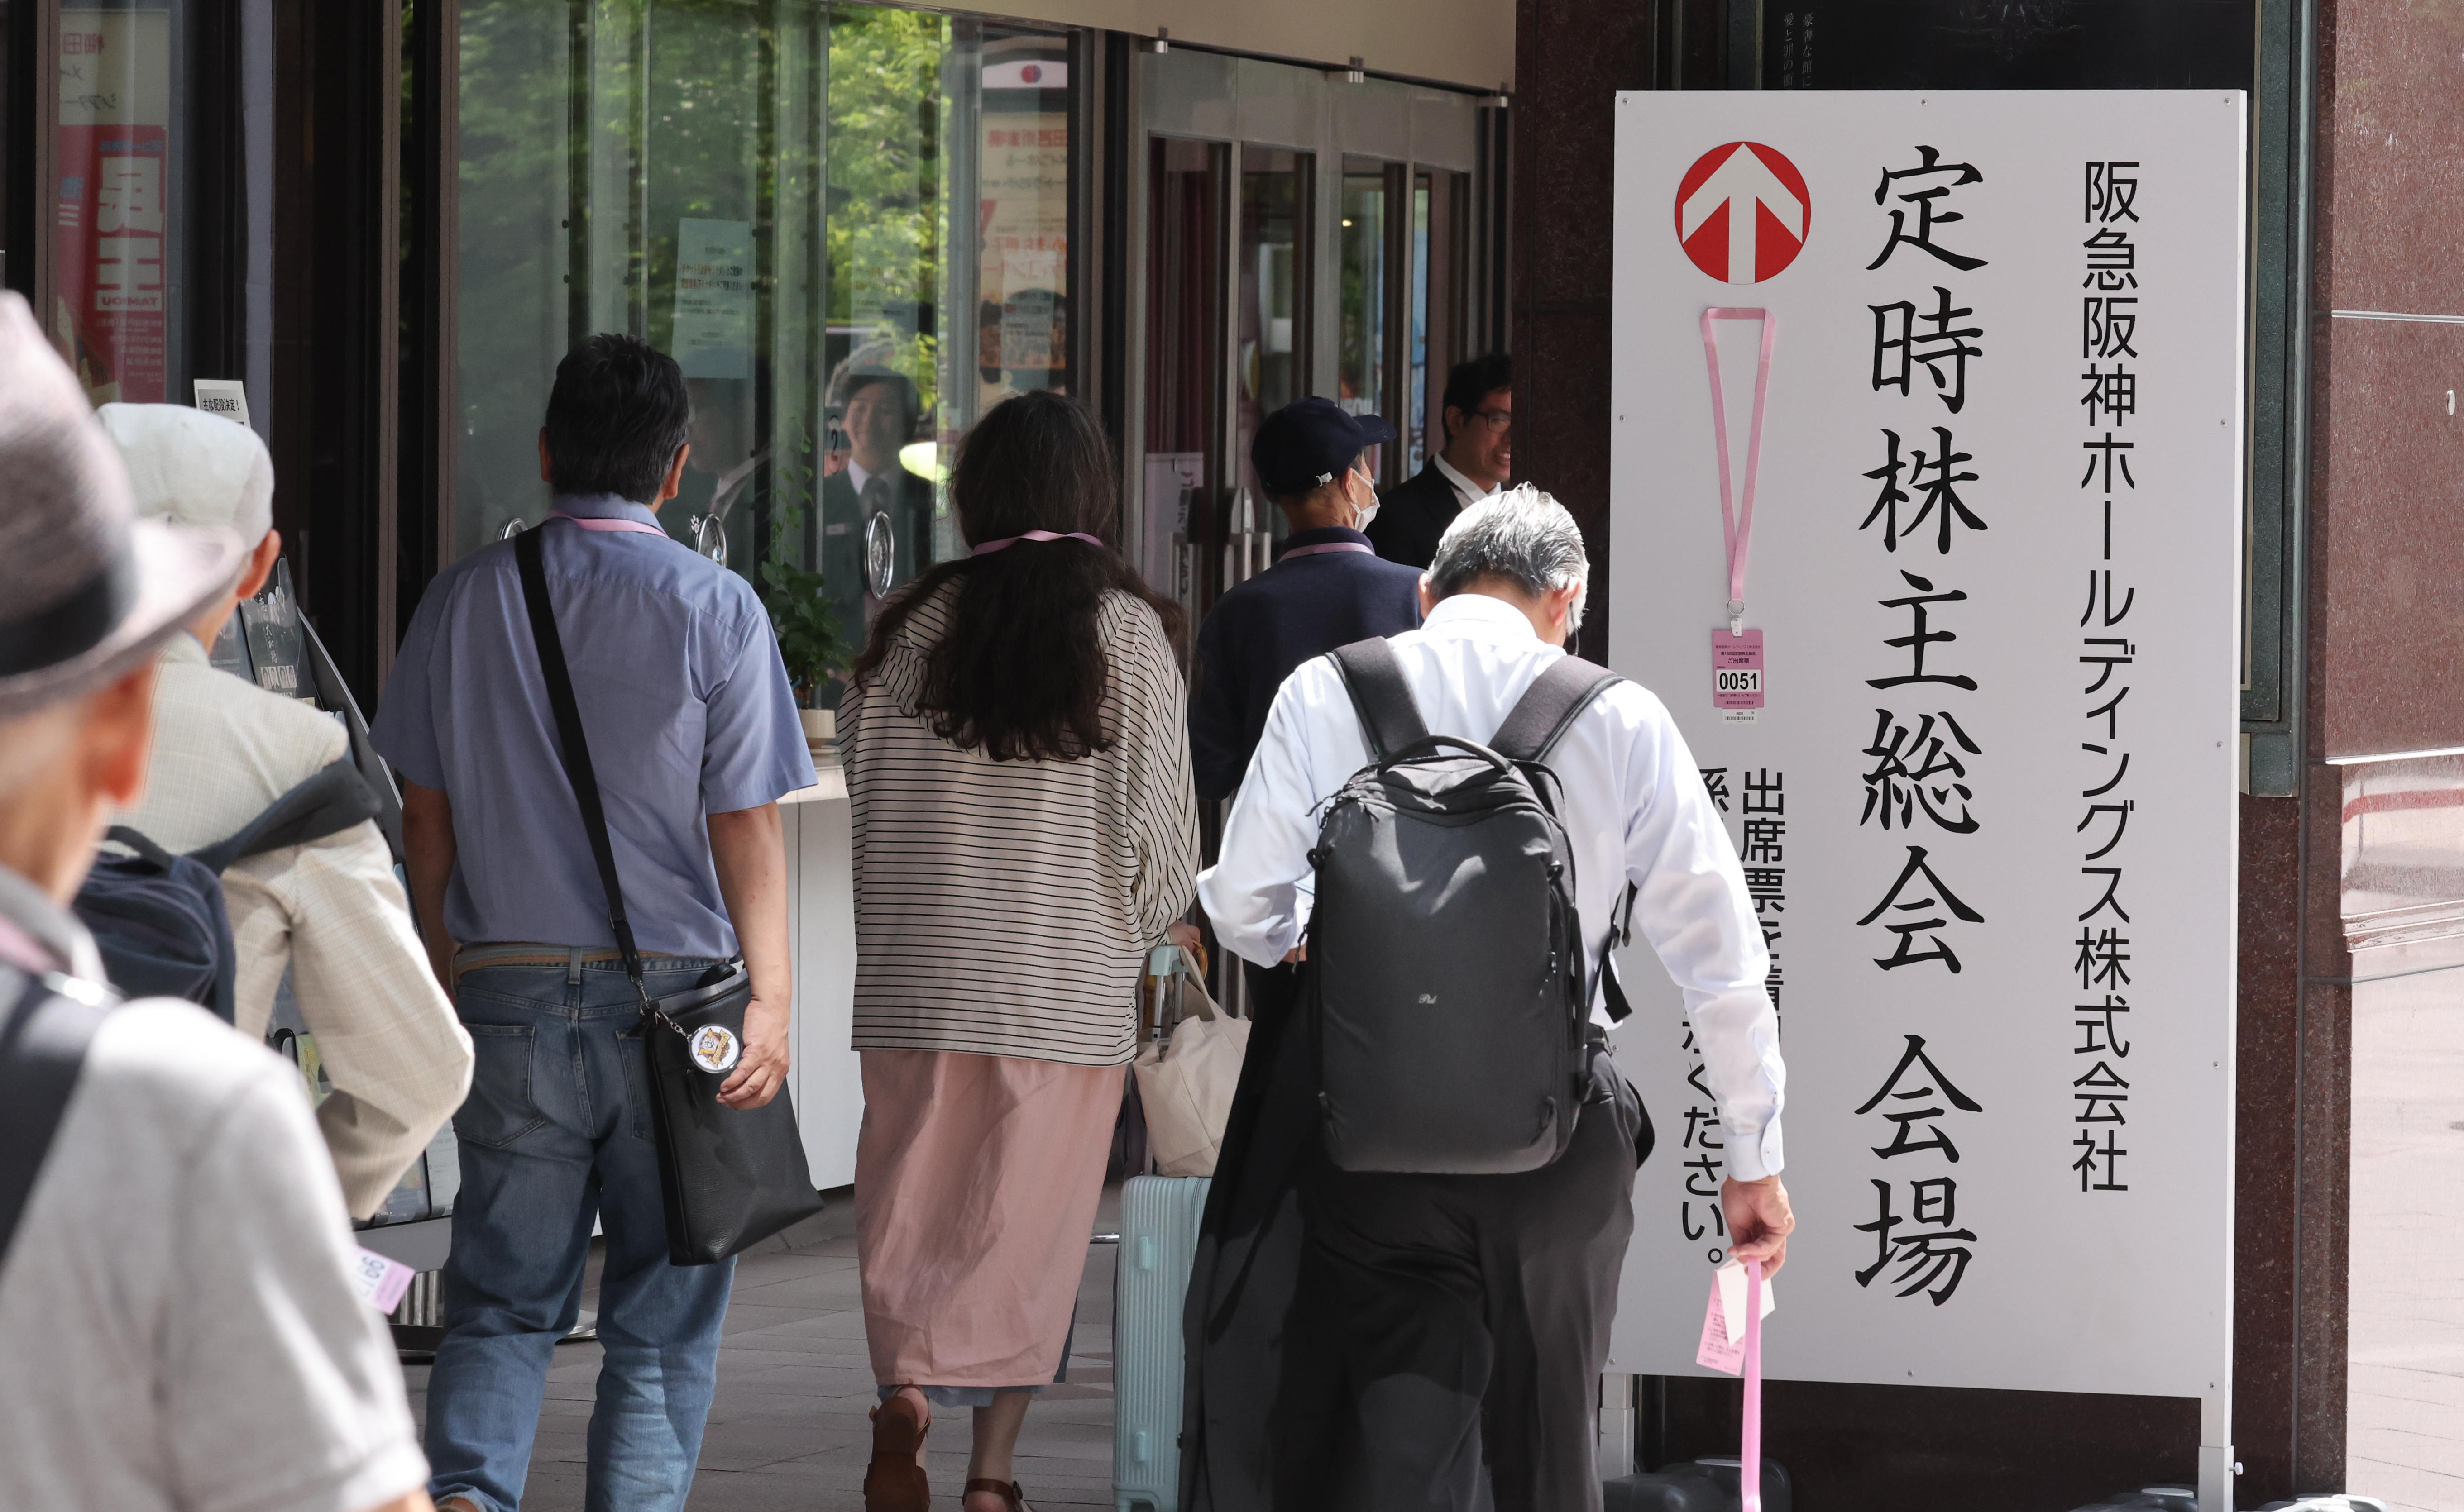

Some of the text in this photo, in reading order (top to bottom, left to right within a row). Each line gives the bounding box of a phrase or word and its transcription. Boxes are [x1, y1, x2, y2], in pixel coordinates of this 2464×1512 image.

[1720, 673, 1756, 690] 0051
[1853, 145, 1988, 1306] 定時株主総会 会場
[2073, 162, 2139, 1192] 阪急阪神ホールディングス株式会社
